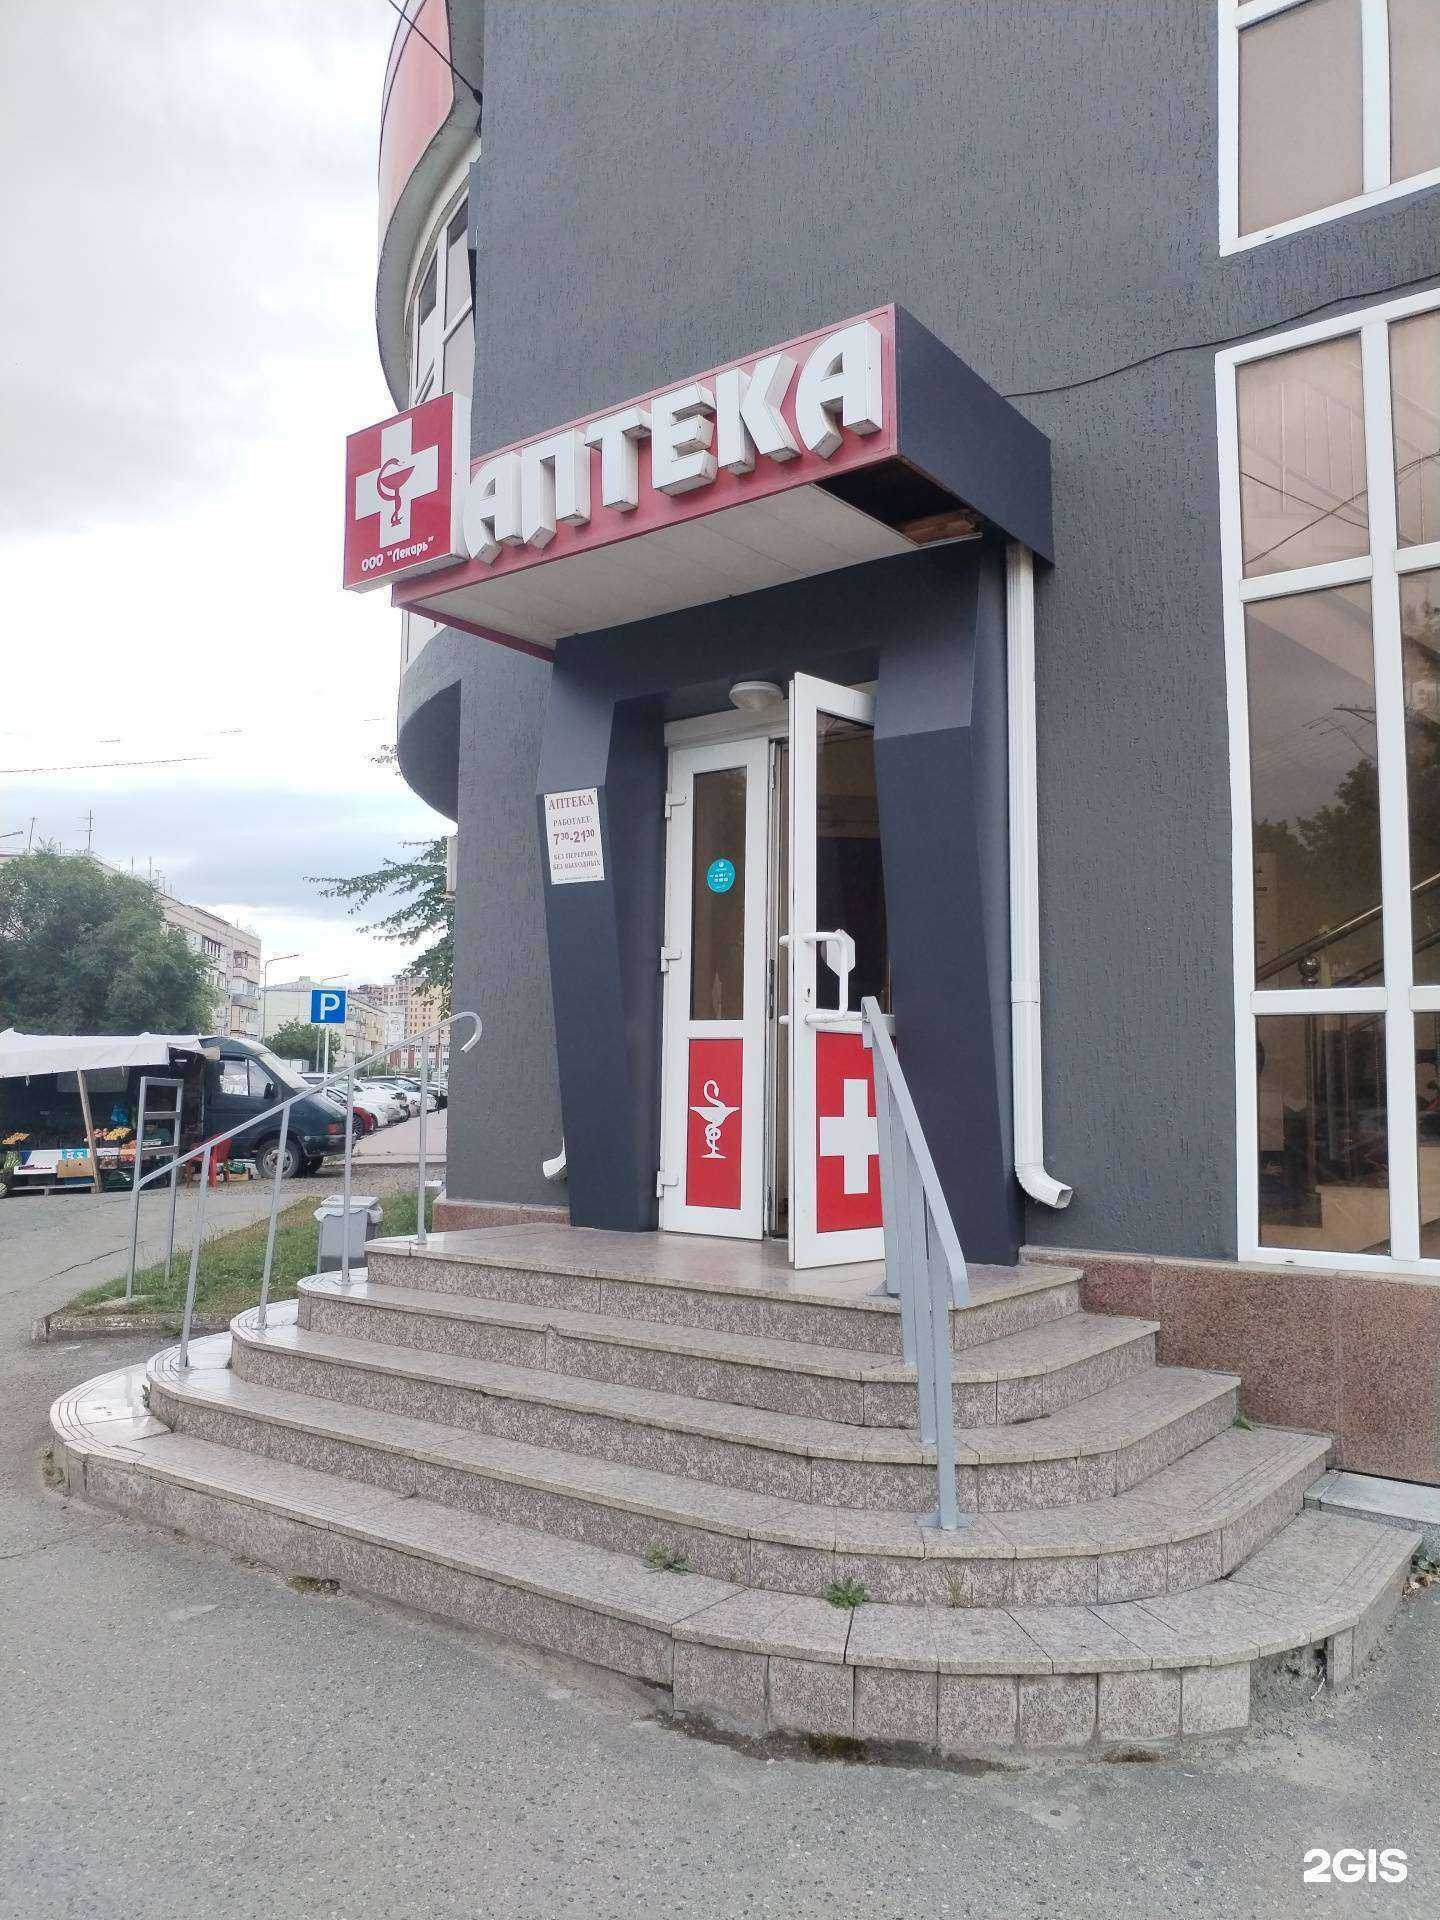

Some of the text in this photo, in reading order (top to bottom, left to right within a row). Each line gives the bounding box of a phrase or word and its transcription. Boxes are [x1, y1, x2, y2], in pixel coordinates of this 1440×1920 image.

[463, 320, 881, 563] АПТЕКА
[361, 553, 384, 572] ООО
[549, 794, 594, 810] АПТЕКА
[320, 993, 340, 1020] P
